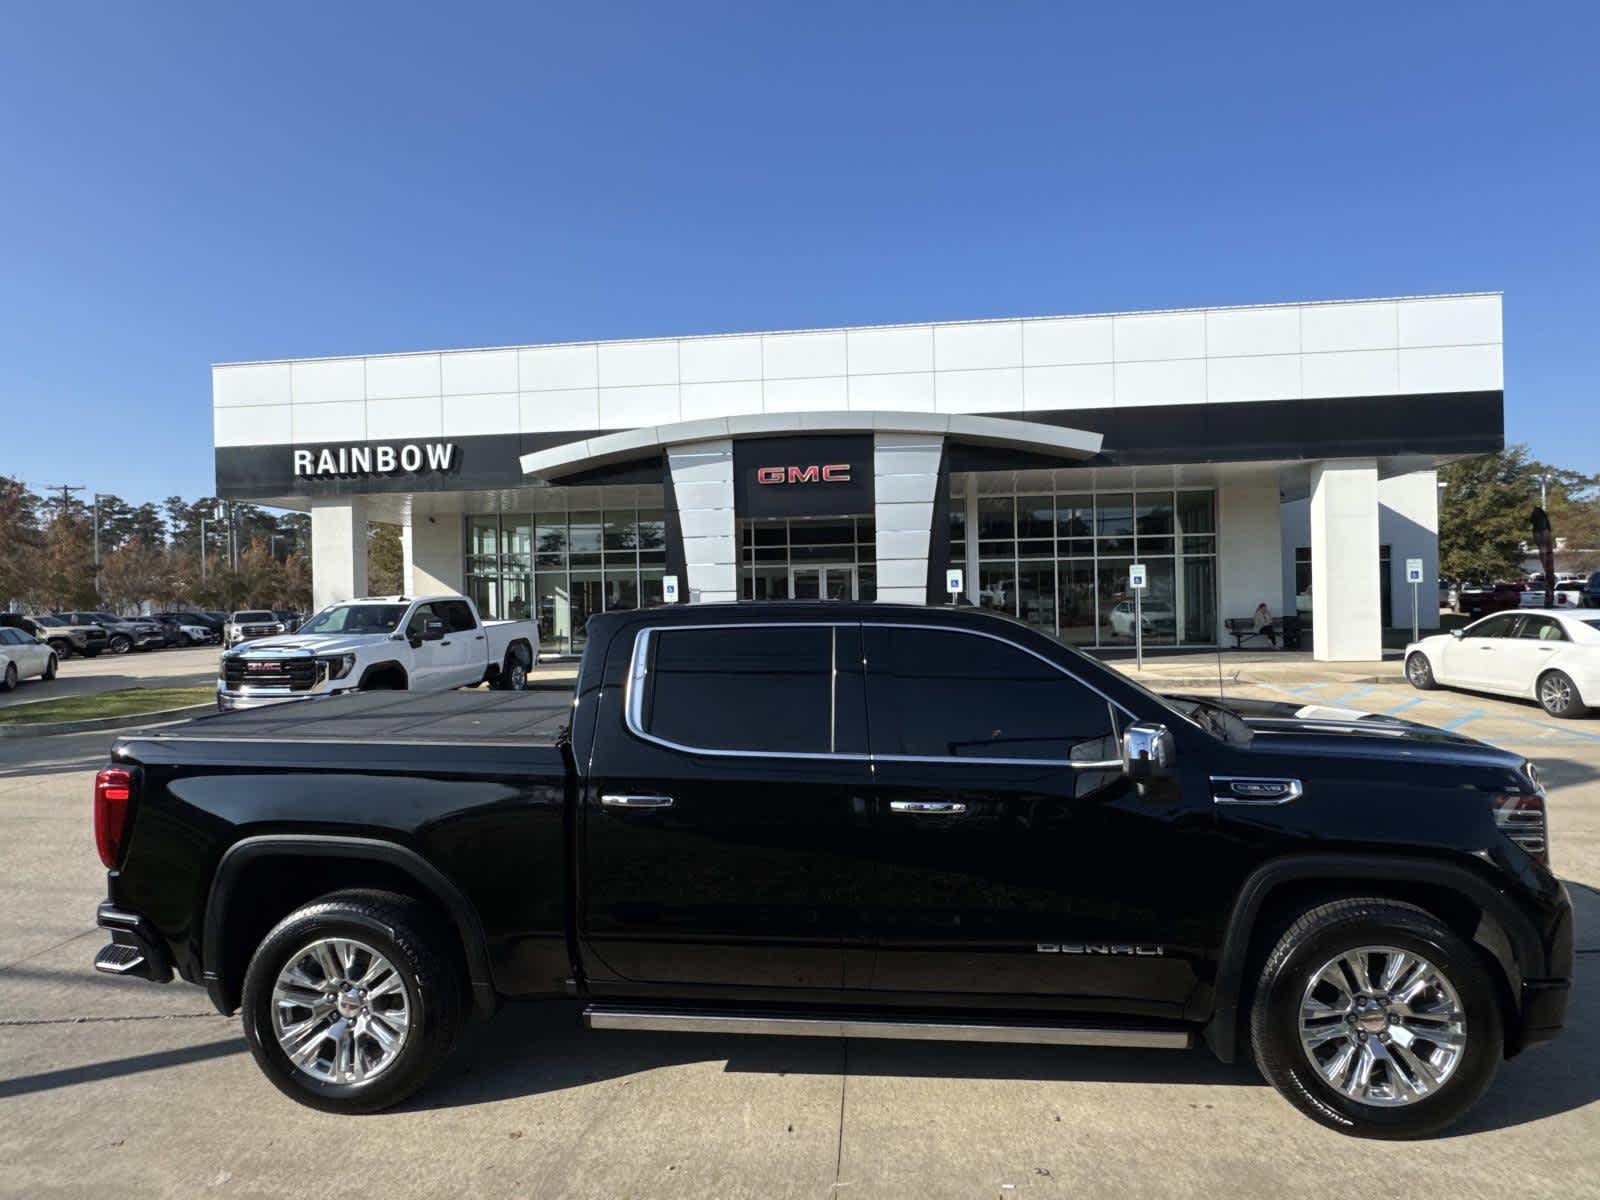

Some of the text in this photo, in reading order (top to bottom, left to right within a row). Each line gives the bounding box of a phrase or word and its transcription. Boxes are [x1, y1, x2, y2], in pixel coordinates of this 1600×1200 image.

[294, 443, 453, 475] RAINBOW
[758, 464, 850, 484] GMC
[1036, 943, 1164, 955] DENALI
